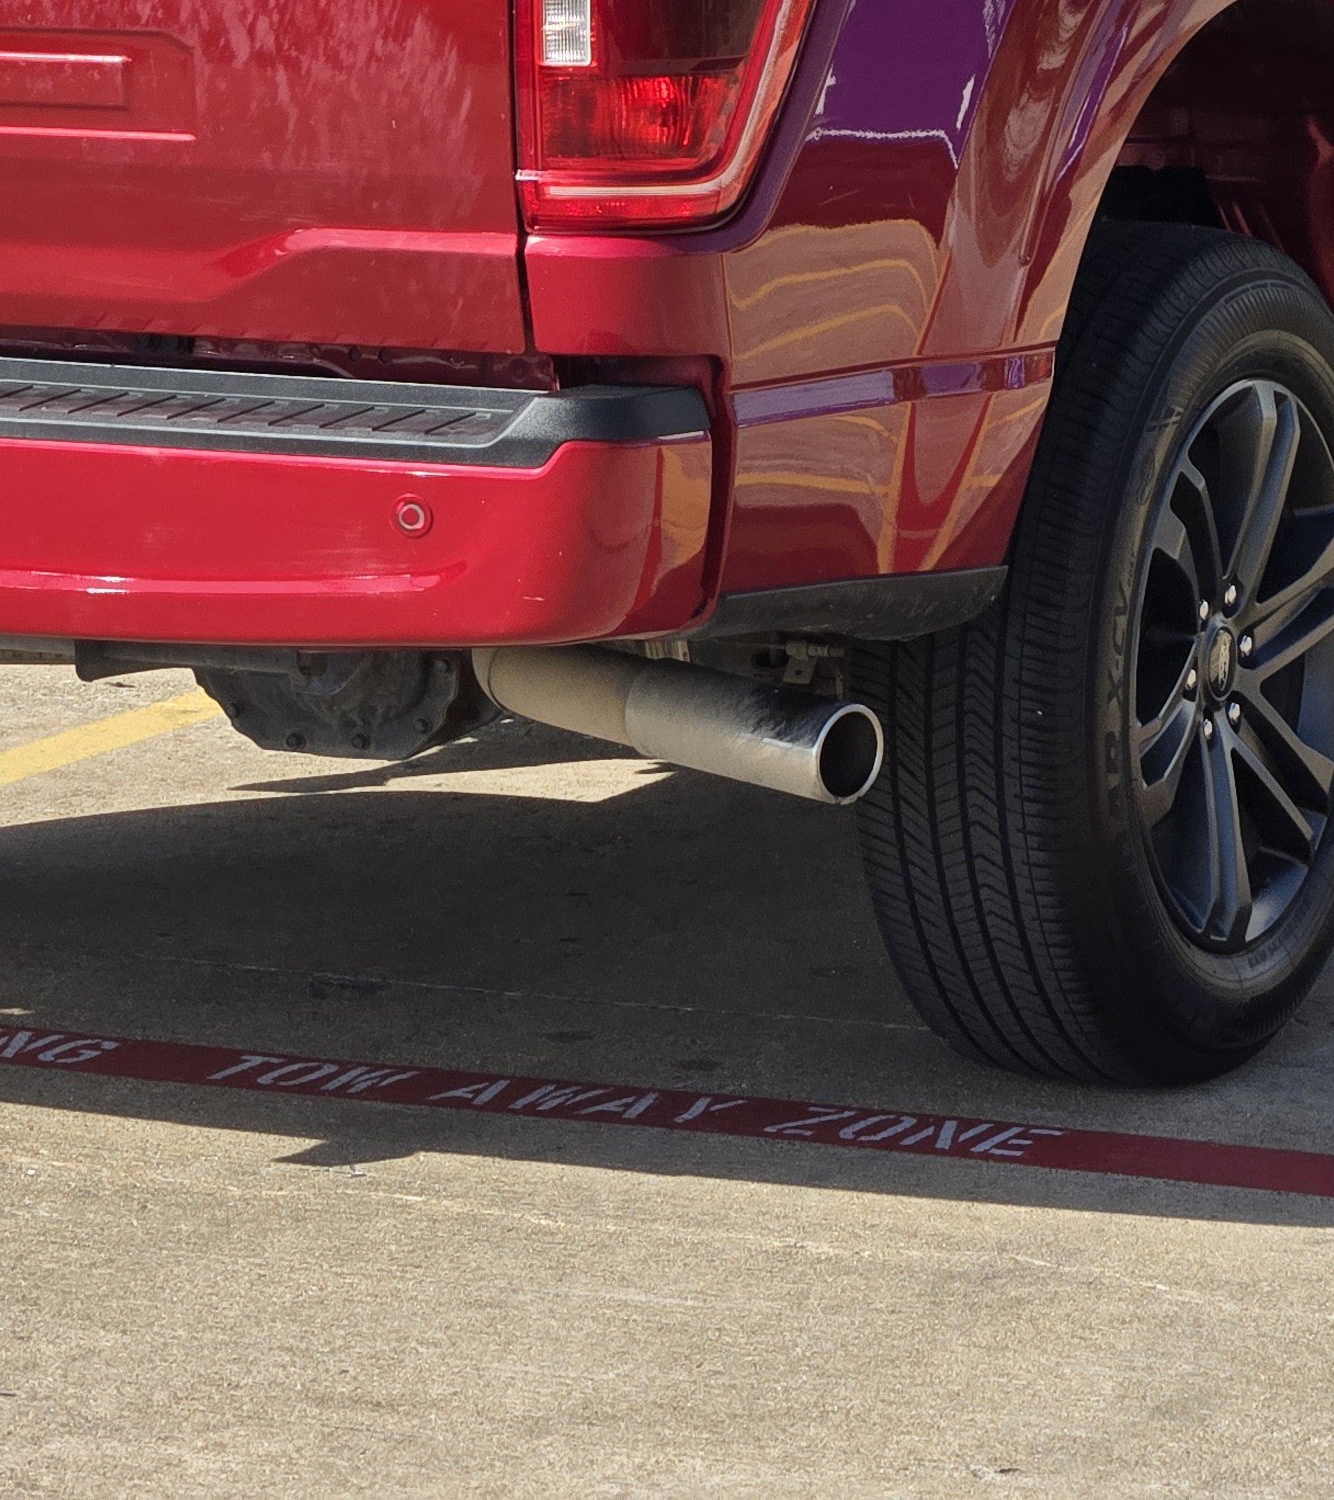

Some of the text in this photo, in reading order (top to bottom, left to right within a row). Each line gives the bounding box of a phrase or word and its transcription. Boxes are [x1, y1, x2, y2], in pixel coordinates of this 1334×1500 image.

[207, 1055, 415, 1094] TOW
[429, 1080, 744, 1124] AWAY
[765, 1108, 1064, 1157] ZONE
